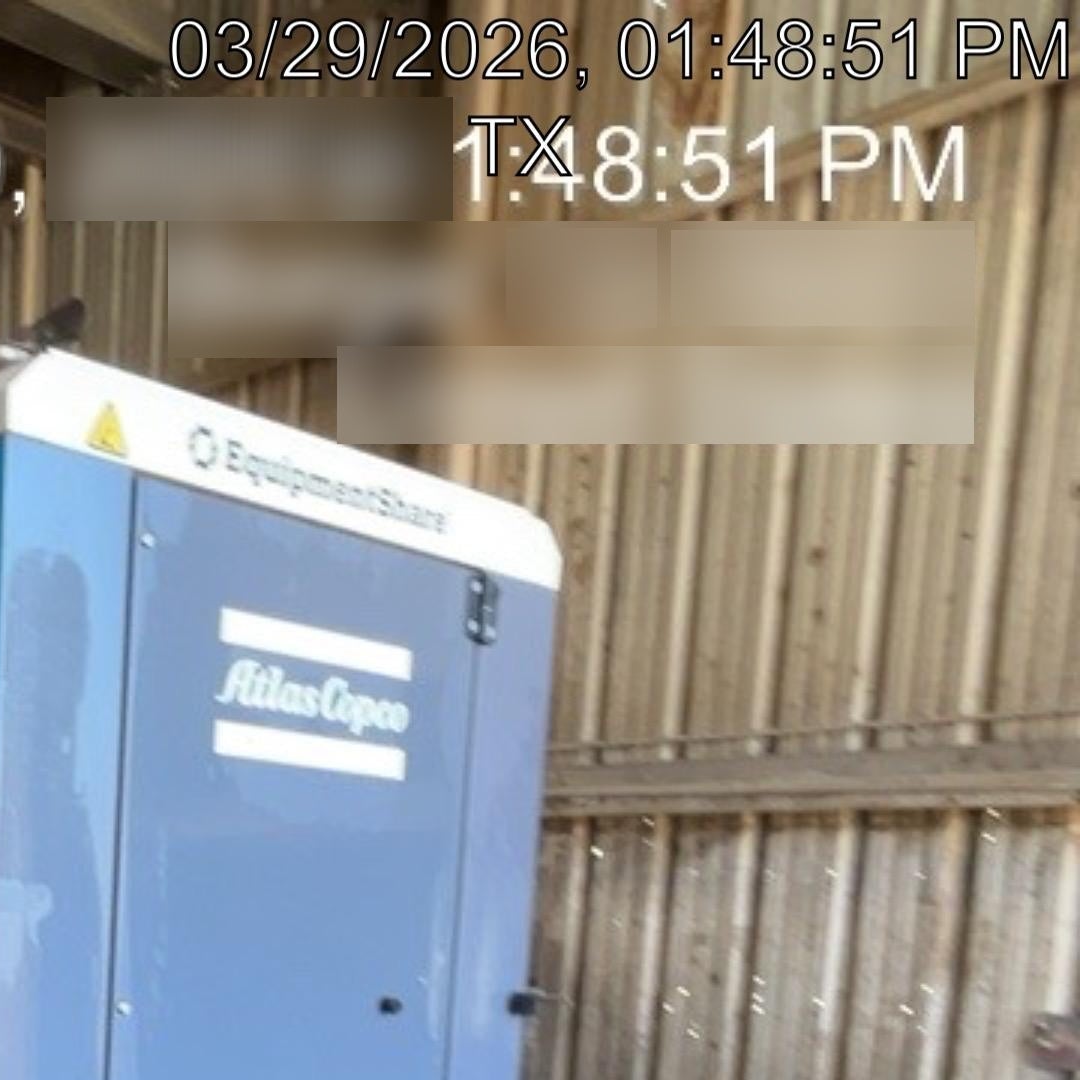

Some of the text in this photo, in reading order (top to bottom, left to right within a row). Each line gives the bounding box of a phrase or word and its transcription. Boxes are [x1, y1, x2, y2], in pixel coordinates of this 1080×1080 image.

[225, 438, 447, 534] EquipmentShare
[215, 659, 410, 736] Atlas Copco
